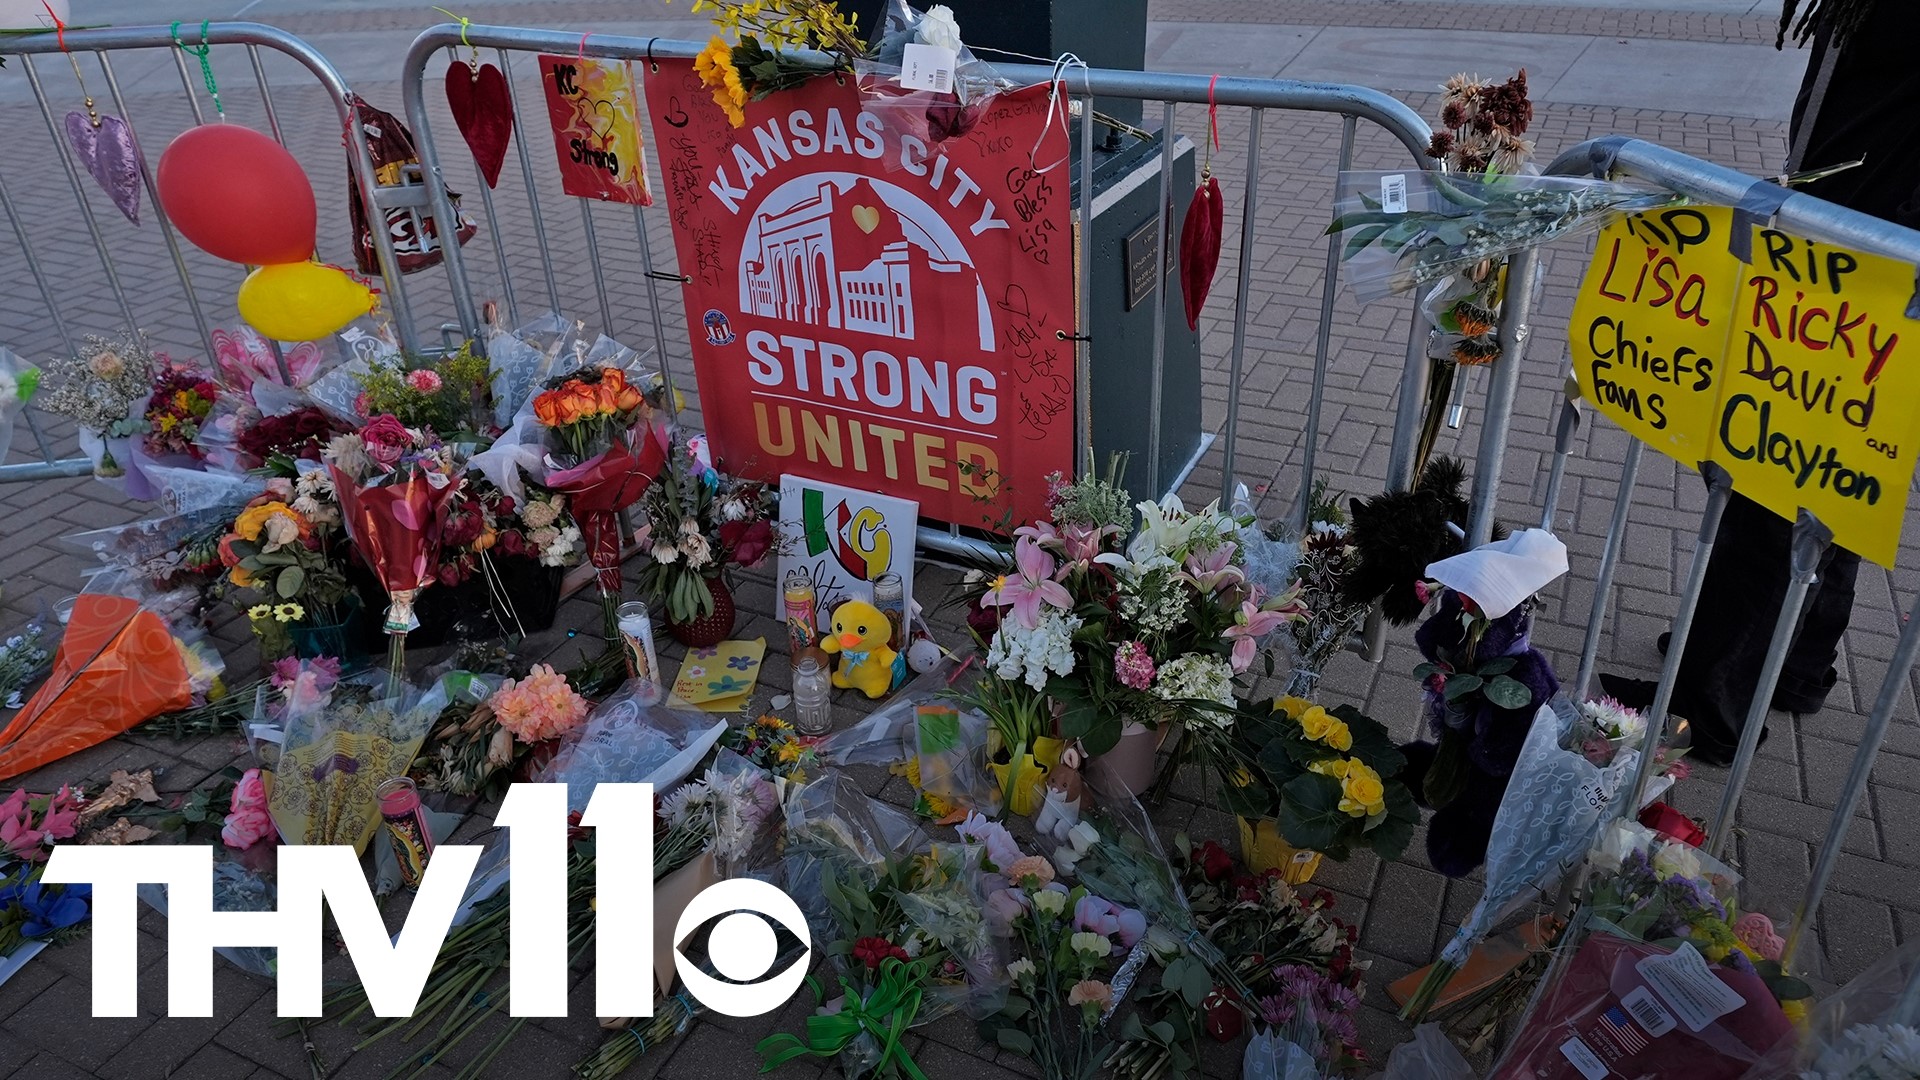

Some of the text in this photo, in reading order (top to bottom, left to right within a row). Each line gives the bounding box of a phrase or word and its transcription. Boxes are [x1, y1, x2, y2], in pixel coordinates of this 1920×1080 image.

[553, 63, 579, 95] KC
[569, 138, 619, 177] Strong
[708, 107, 885, 215] KANSAS
[900, 134, 1010, 237] CITY
[1014, 176, 1053, 223] Bless
[1599, 238, 1710, 327] Lisa
[1749, 276, 1899, 386] Ricky
[746, 330, 997, 425] STRONG
[1592, 359, 1667, 430] Fans
[1739, 330, 1876, 432] David
[753, 401, 999, 499] UNITED
[1720, 393, 1881, 506] Clayton
[1866, 437, 1898, 460] and
